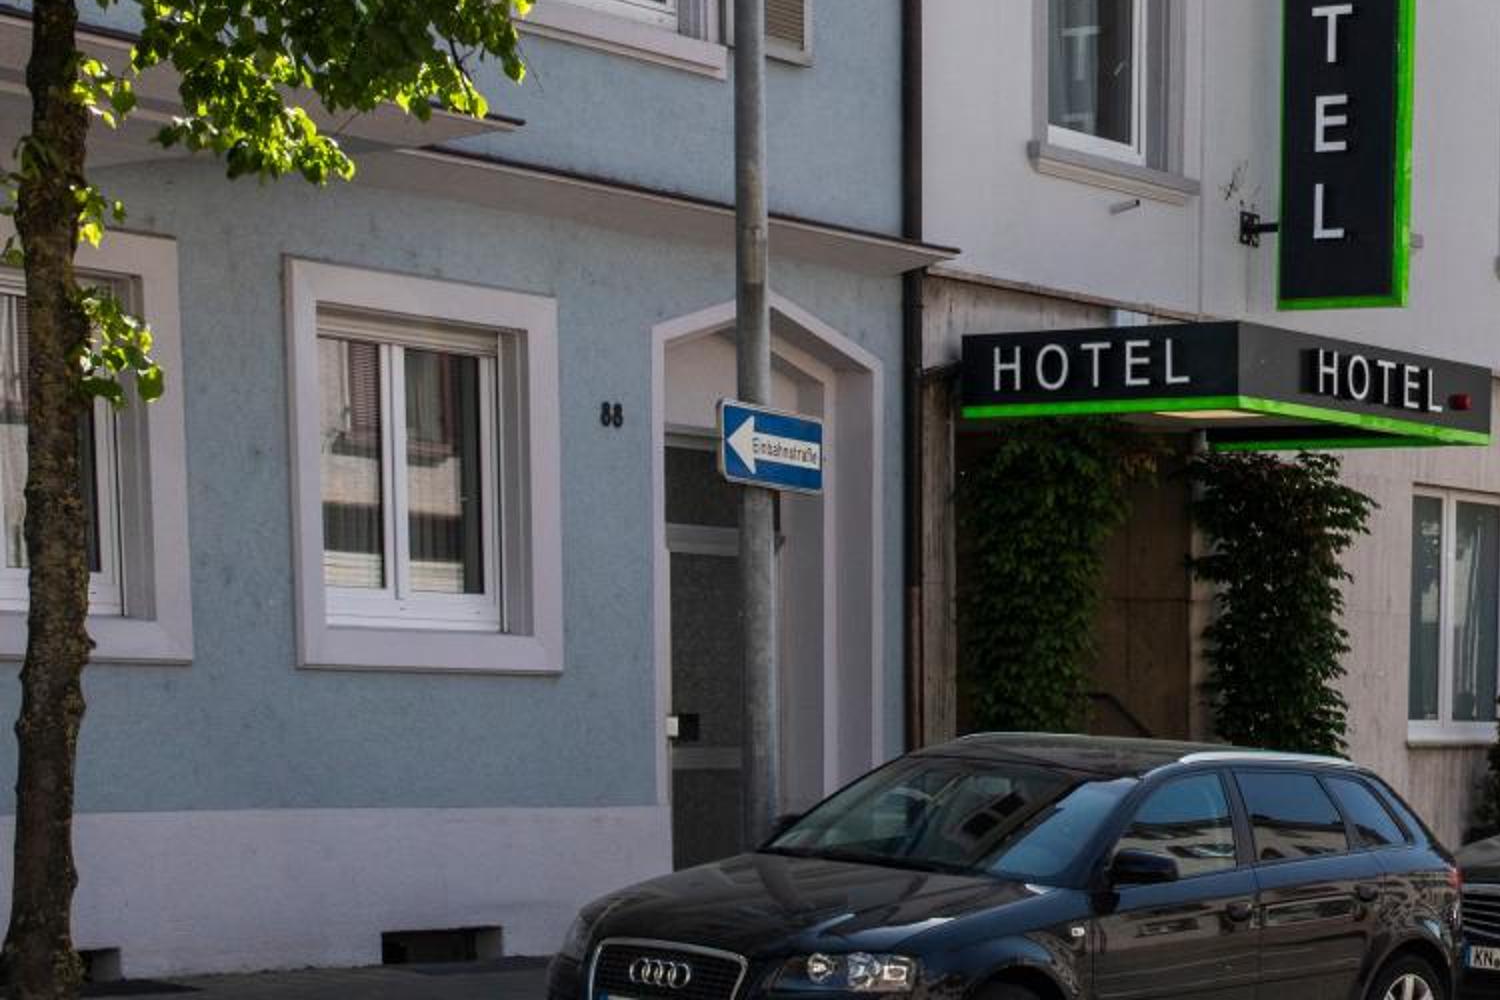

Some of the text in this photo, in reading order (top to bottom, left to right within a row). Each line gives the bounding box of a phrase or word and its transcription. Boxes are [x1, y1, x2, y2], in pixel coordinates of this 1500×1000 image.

[993, 338, 1190, 391] HOTEL
[1318, 348, 1443, 412] HOTEL
[601, 401, 623, 427] 88
[1474, 949, 1493, 967] KN
